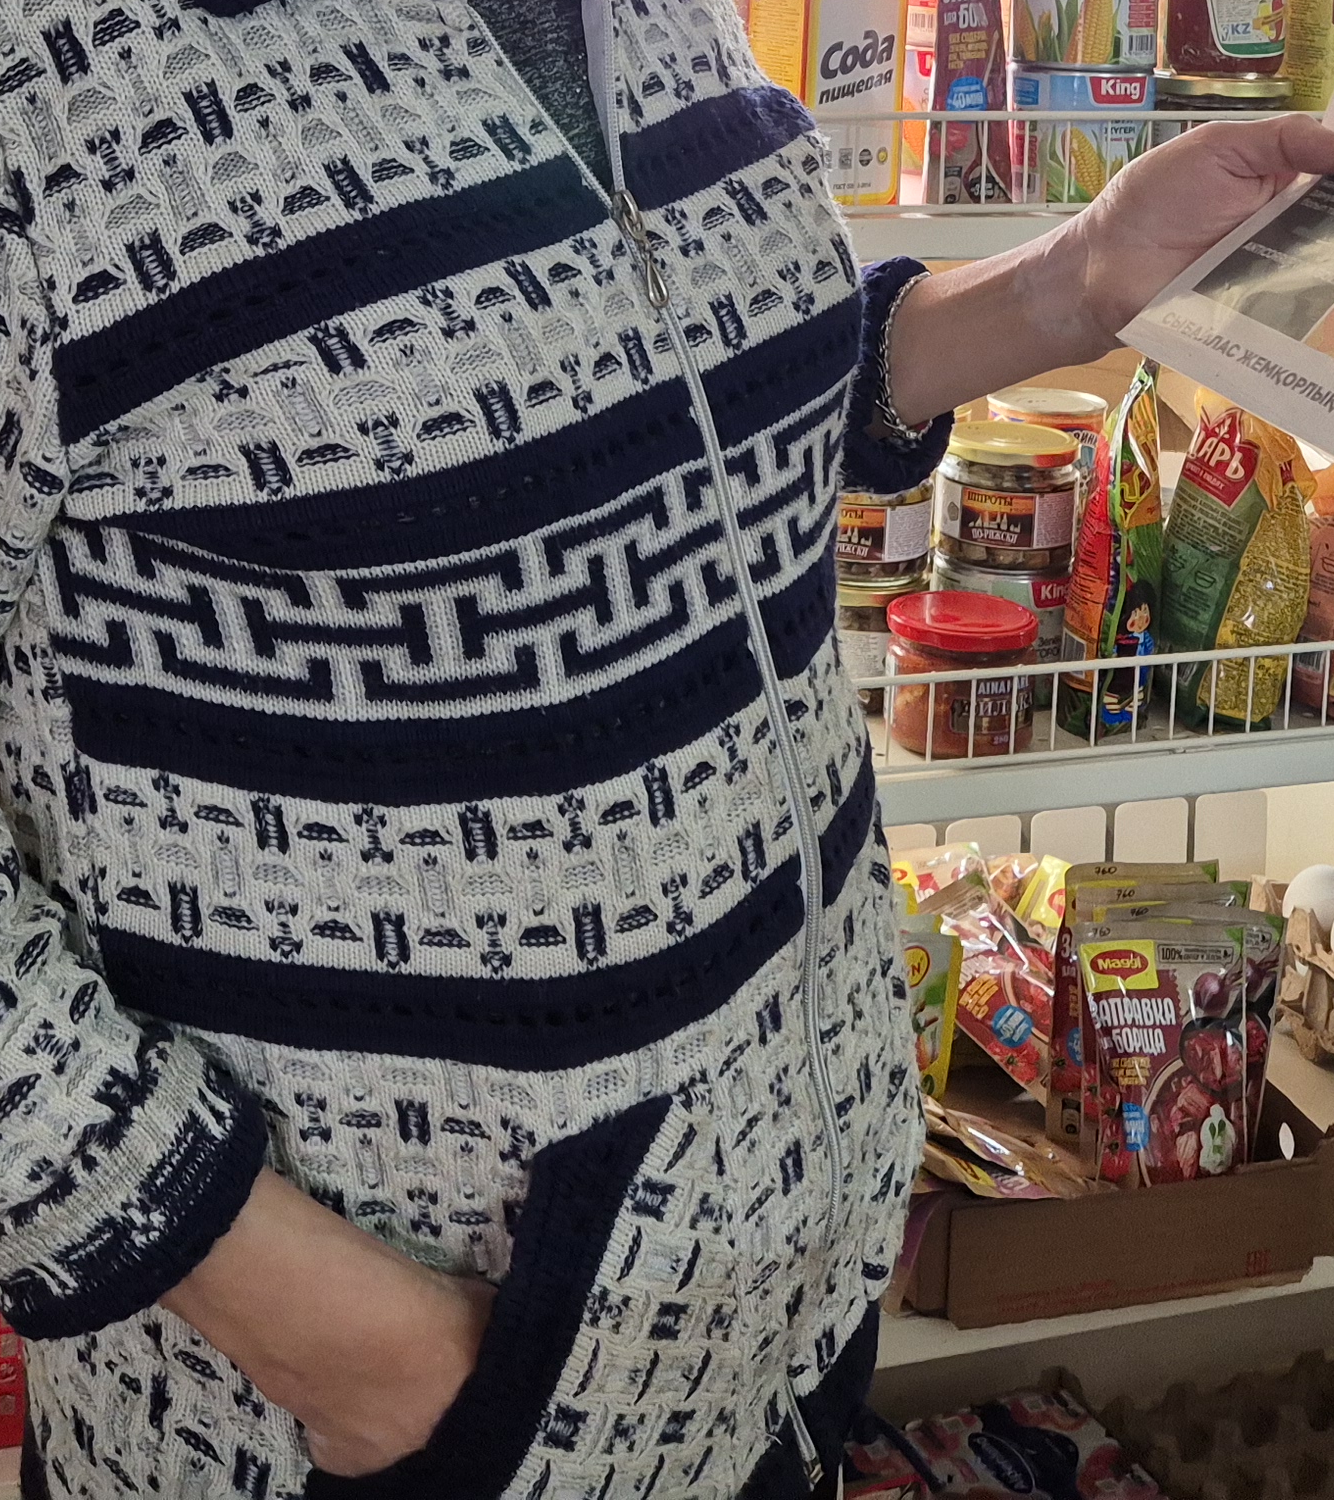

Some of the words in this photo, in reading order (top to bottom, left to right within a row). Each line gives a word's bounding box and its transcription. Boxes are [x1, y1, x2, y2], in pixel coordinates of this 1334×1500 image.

[819, 29, 896, 80] Сода
[817, 68, 895, 106] пищевая
[1100, 78, 1141, 100] King
[1161, 310, 1239, 359] СЫБАЙЛАС
[966, 490, 1014, 507] ШПРОТЫ
[971, 529, 1018, 544] ПО-РИЖСКИ
[1094, 865, 1118, 877] 760
[1092, 927, 1111, 938] 760
[1160, 946, 1184, 961] 100%
[1112, 1027, 1168, 1056] БОРЩА
